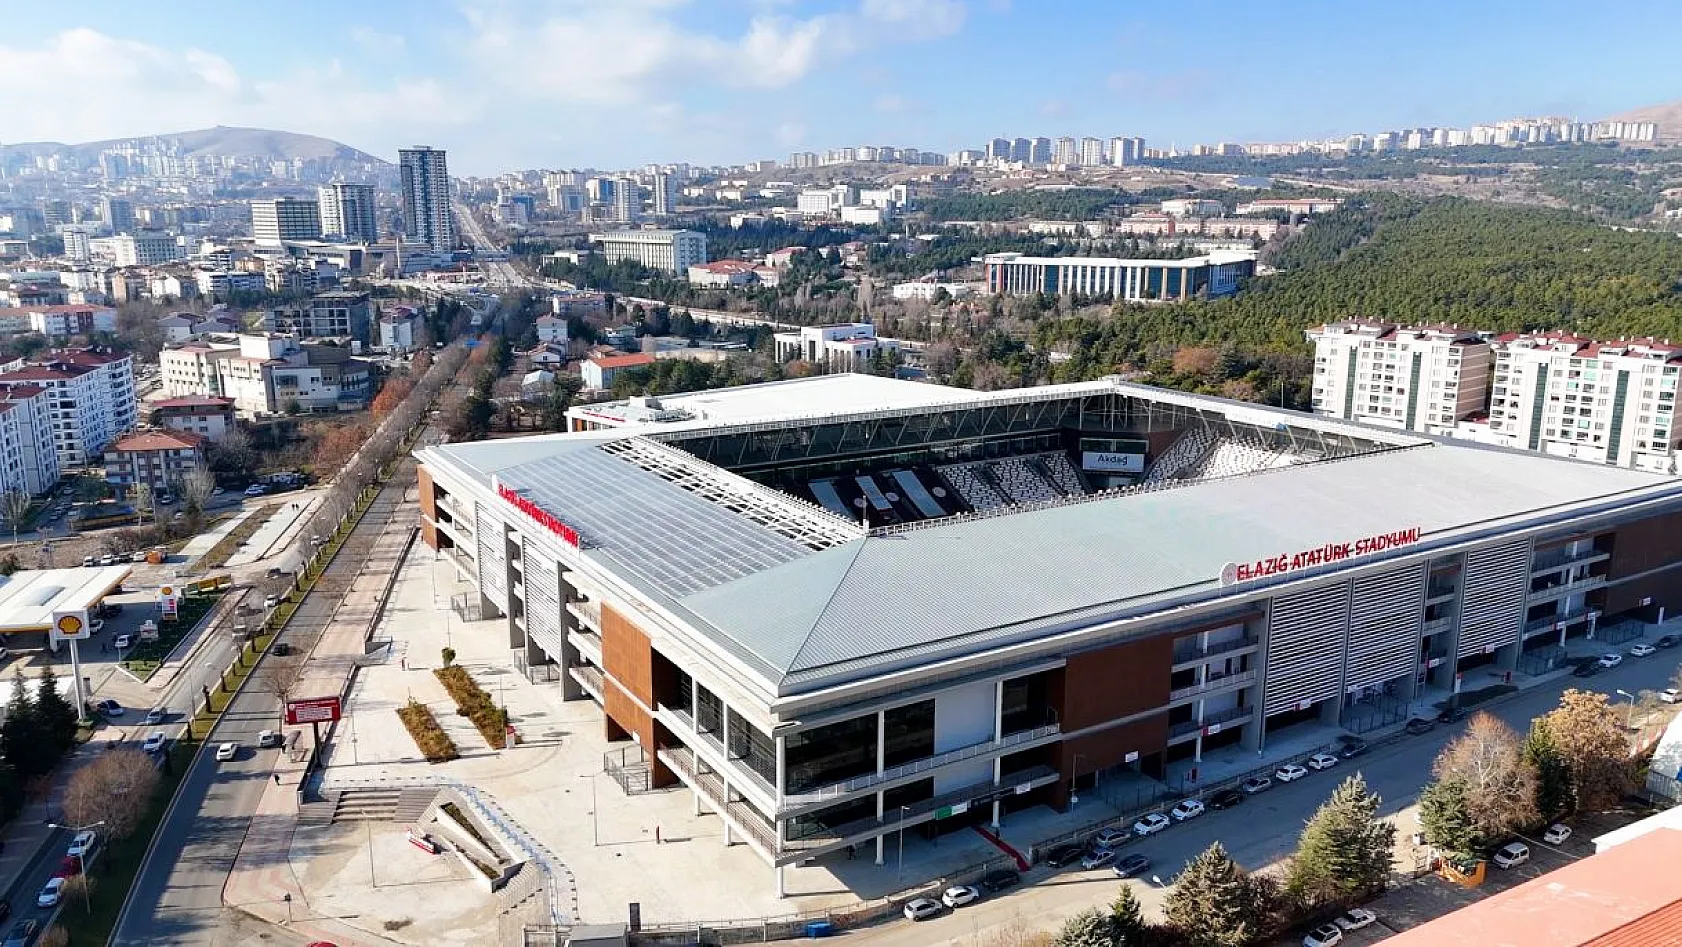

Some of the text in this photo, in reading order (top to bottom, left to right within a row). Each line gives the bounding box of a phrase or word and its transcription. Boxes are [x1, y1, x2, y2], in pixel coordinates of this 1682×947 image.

[1236, 526, 1421, 581] ELAZIĞ ATATÜRK STADYUMU
